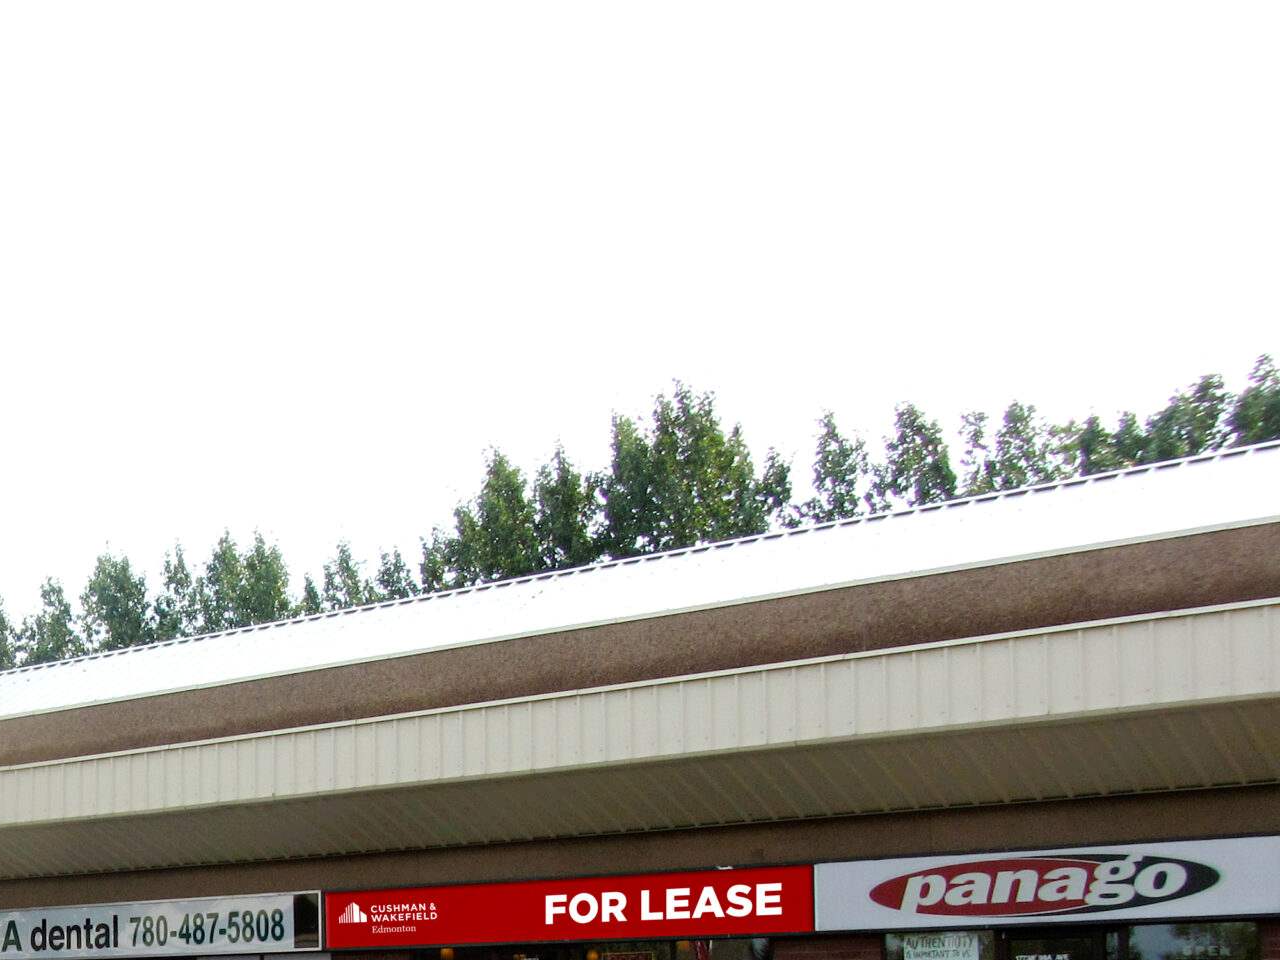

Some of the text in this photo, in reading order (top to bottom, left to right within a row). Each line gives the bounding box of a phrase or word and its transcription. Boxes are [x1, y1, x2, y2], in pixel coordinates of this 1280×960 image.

[900, 853, 1188, 914] panago
[370, 902, 437, 913] CUSHMAN &
[371, 911, 437, 922] WAKEFIELD
[544, 882, 783, 925] FOR LEASE
[30, 914, 119, 952] dental
[129, 908, 285, 948] 780-487-5808
[372, 925, 417, 934] Edmonton
